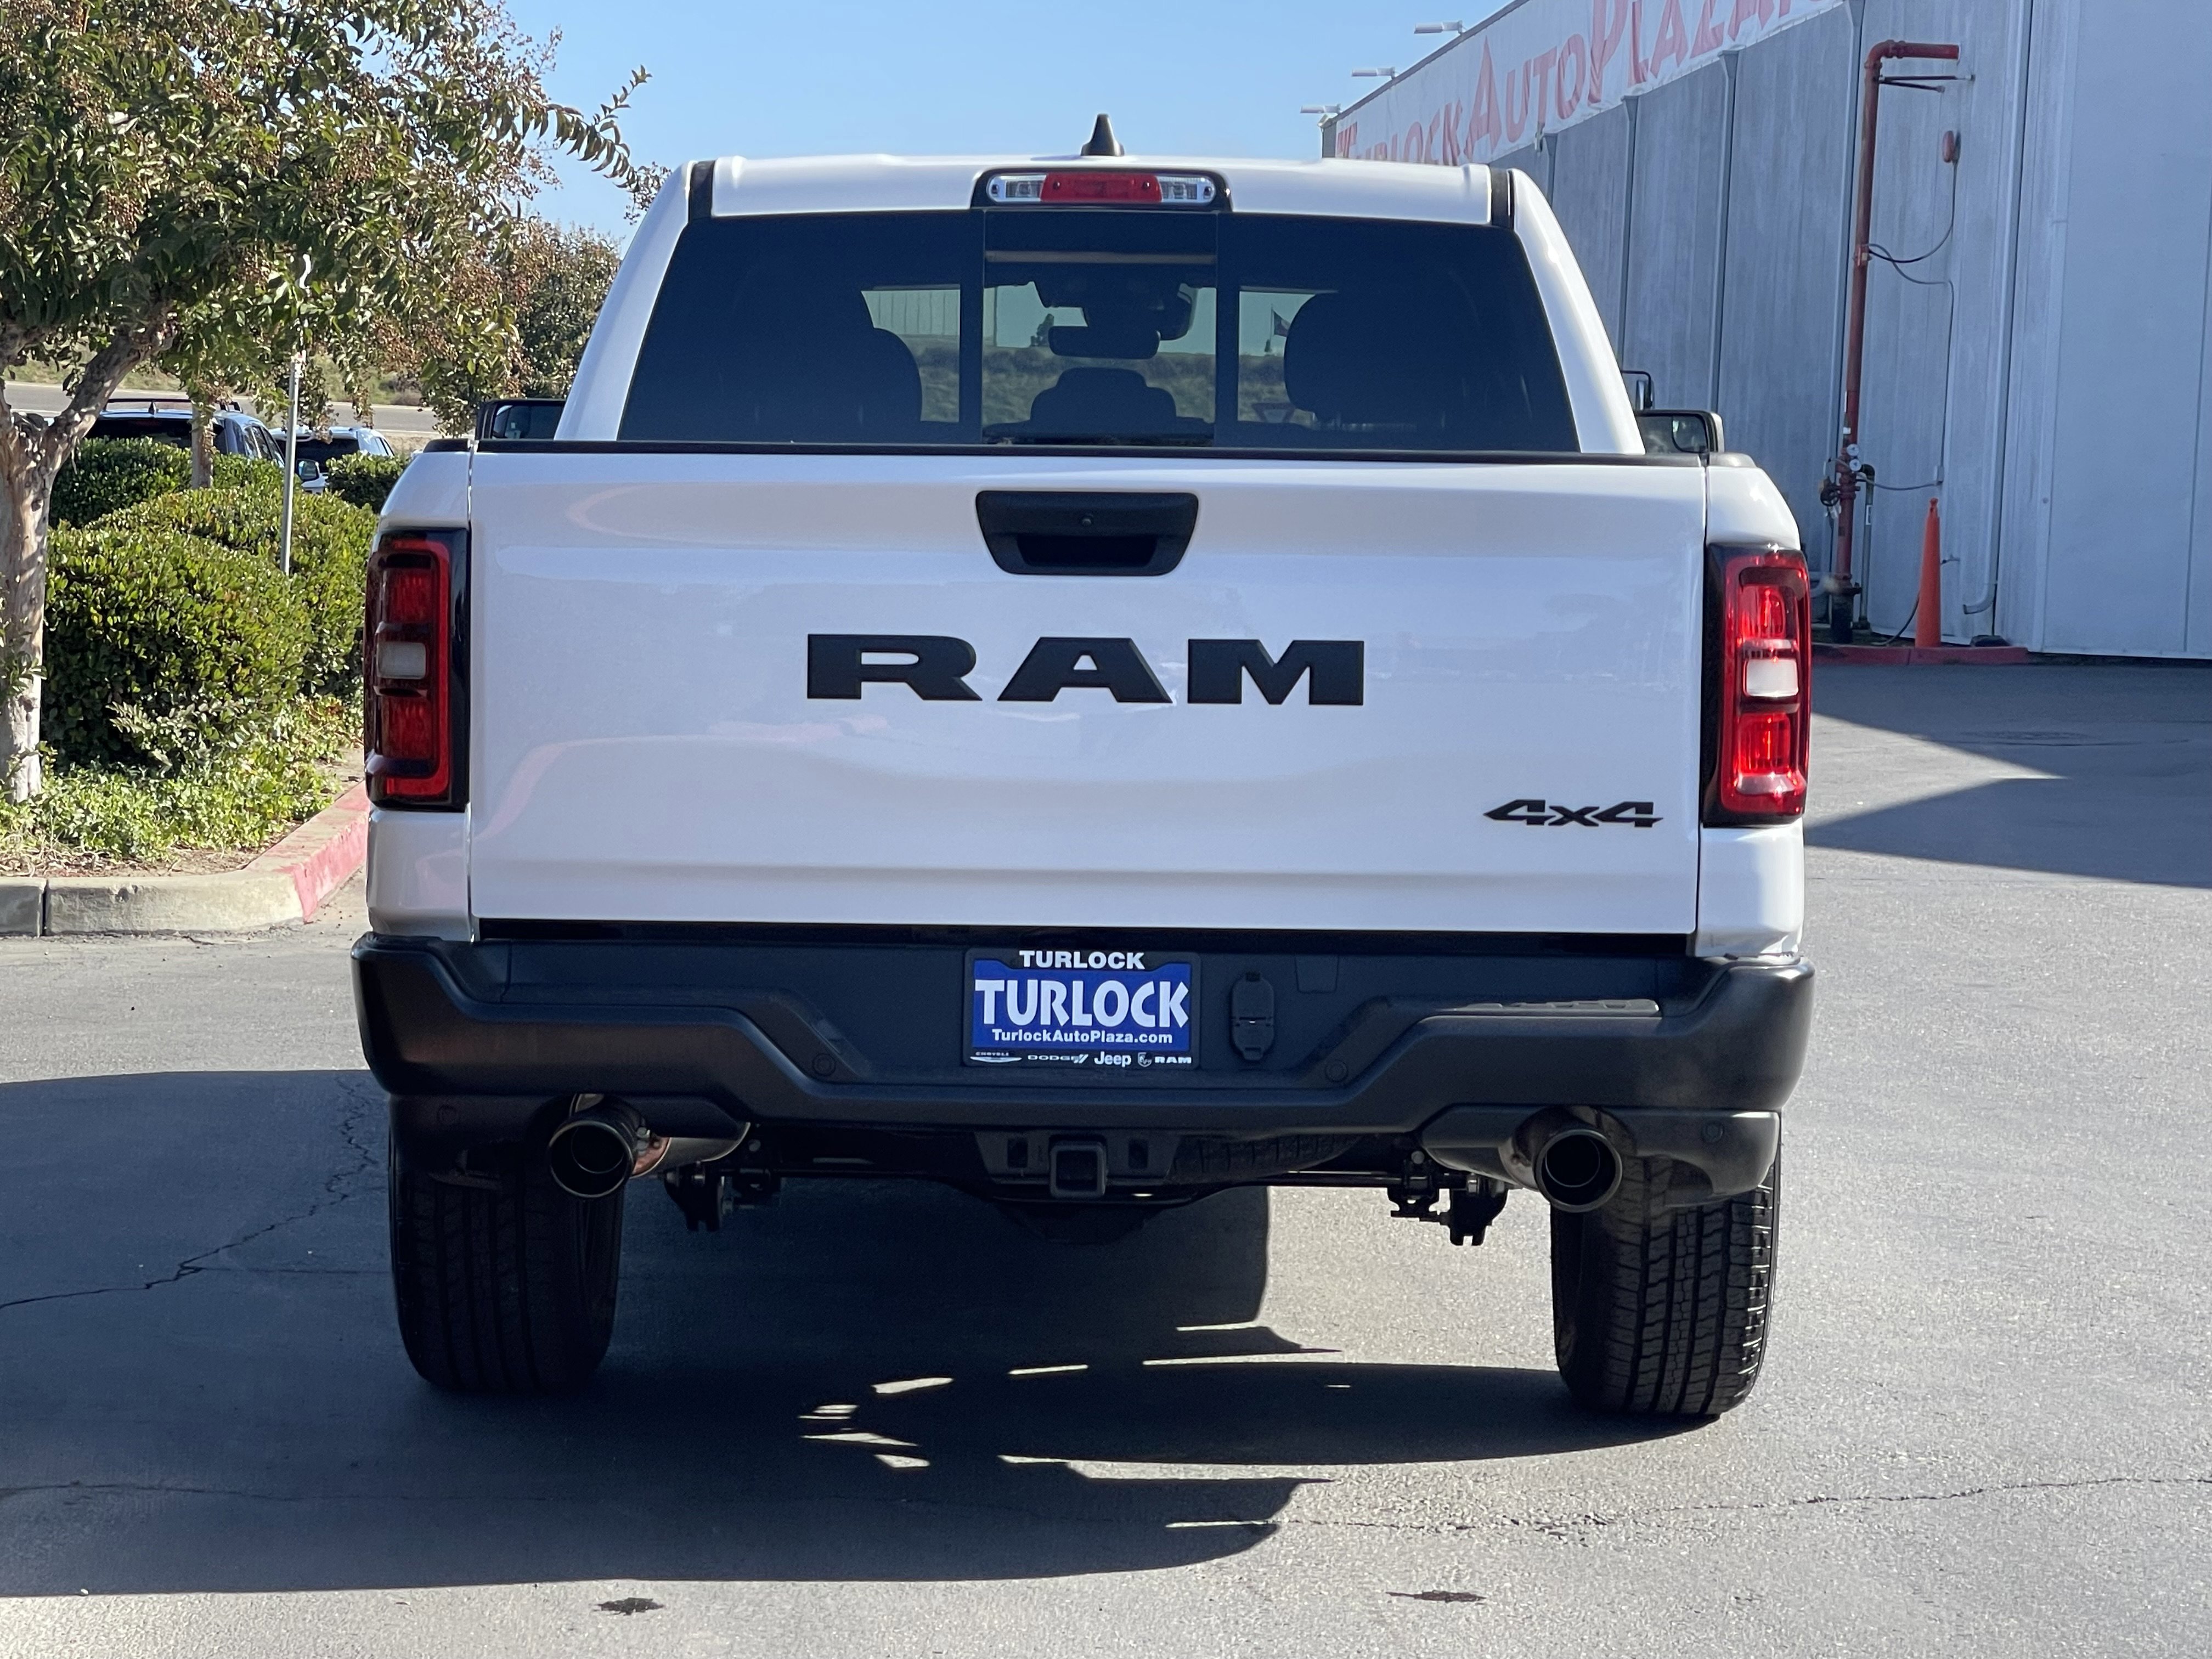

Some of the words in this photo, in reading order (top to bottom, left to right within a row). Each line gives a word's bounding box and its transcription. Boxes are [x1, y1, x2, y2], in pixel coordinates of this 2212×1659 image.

[1336, 97, 1463, 166] TLOCK
[806, 634, 1365, 706] RAM
[1483, 799, 1663, 828] 4x4
[1019, 950, 1146, 970] TURLOCK
[975, 979, 1189, 1028] TURLOCK
[991, 1028, 1172, 1044] TurlockAutoPlaza.com
[1094, 1051, 1132, 1068] Jeep
